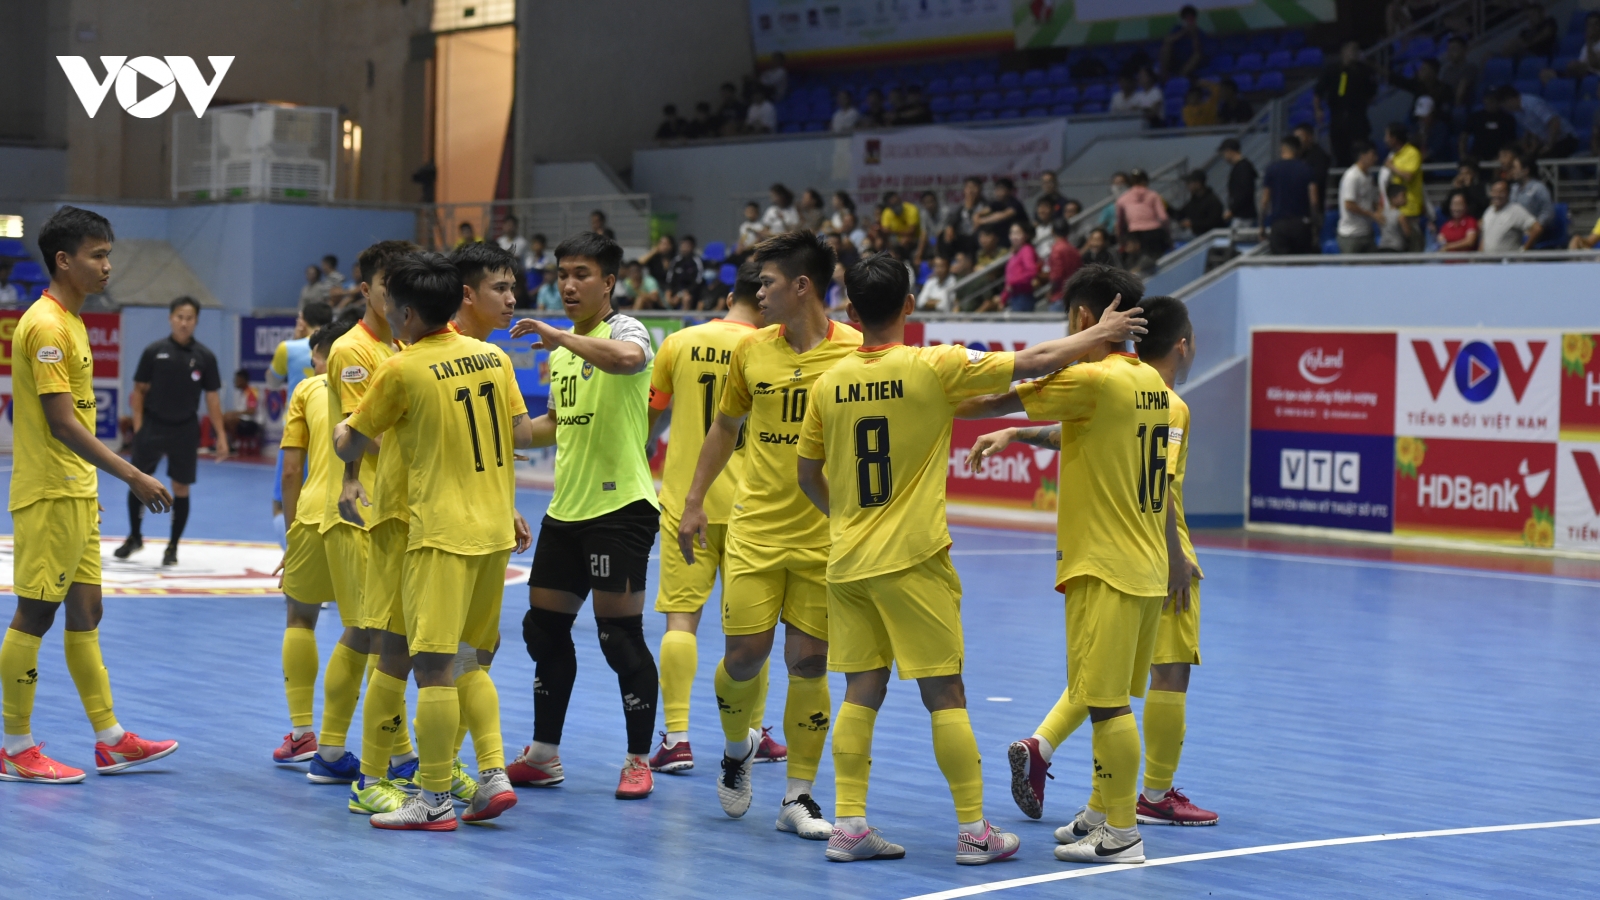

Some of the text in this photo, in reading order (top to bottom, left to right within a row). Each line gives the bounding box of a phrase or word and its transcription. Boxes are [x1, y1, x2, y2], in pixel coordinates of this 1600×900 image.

[429, 352, 502, 380] T.N.TRUNG
[691, 346, 731, 365] K.D.H
[1411, 340, 1548, 405] VOV
[560, 375, 577, 408] 20
[781, 388, 808, 423] 10
[835, 379, 904, 404] L.N.TIEN
[454, 381, 503, 472] 11
[557, 413, 595, 425] AHAKO
[759, 432, 800, 445] SAHA
[854, 416, 892, 508] 8
[1136, 423, 1169, 513] 16
[1283, 453, 1357, 489] VTC
[1417, 473, 1520, 513] HDBank
[1567, 522, 1599, 542] TIẾN
[590, 554, 610, 577] 20
